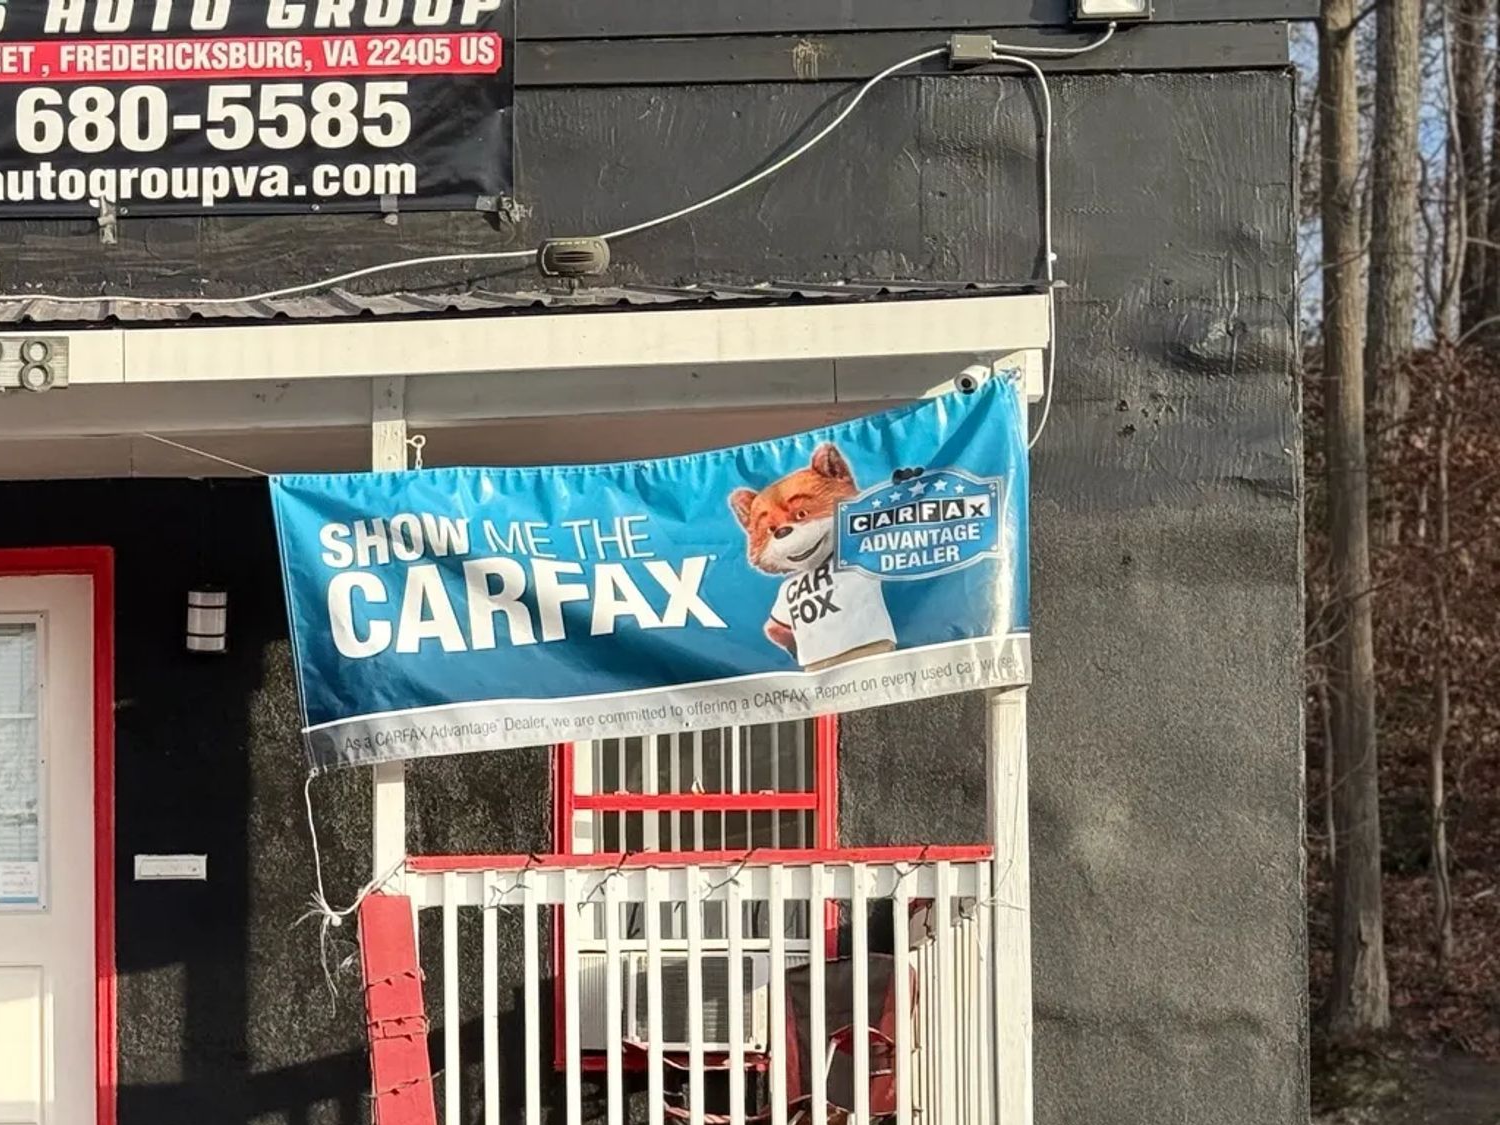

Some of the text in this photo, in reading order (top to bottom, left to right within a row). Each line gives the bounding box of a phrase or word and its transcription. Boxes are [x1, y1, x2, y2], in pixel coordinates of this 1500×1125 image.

[43, 0, 230, 33] AUTO
[60, 40, 313, 73] FREDERICKSBURG,
[325, 40, 359, 67] VA
[367, 37, 451, 66] 22405
[459, 36, 496, 66] US
[15, 81, 411, 155] 680-5585
[851, 500, 987, 532] CARFAX
[318, 511, 656, 569] SHOW ME THE
[858, 522, 982, 554] ADVANTAGE
[880, 545, 961, 572] DEALER
[786, 561, 834, 605] CAR
[327, 554, 729, 660] CARFAX
[789, 588, 842, 631] FOX
[345, 737, 361, 750] As
[365, 737, 373, 748] a
[374, 727, 428, 747] CARFAX
[552, 717, 570, 728] we
[574, 714, 595, 728] are
[598, 705, 666, 726] committed
[670, 705, 684, 717] to
[687, 698, 737, 716] offering
[741, 698, 750, 709] a
[753, 688, 809, 709] CARFAX
[815, 680, 857, 700] Report
[861, 676, 878, 690] on
[881, 669, 918, 688] every
[921, 661, 953, 681] used
